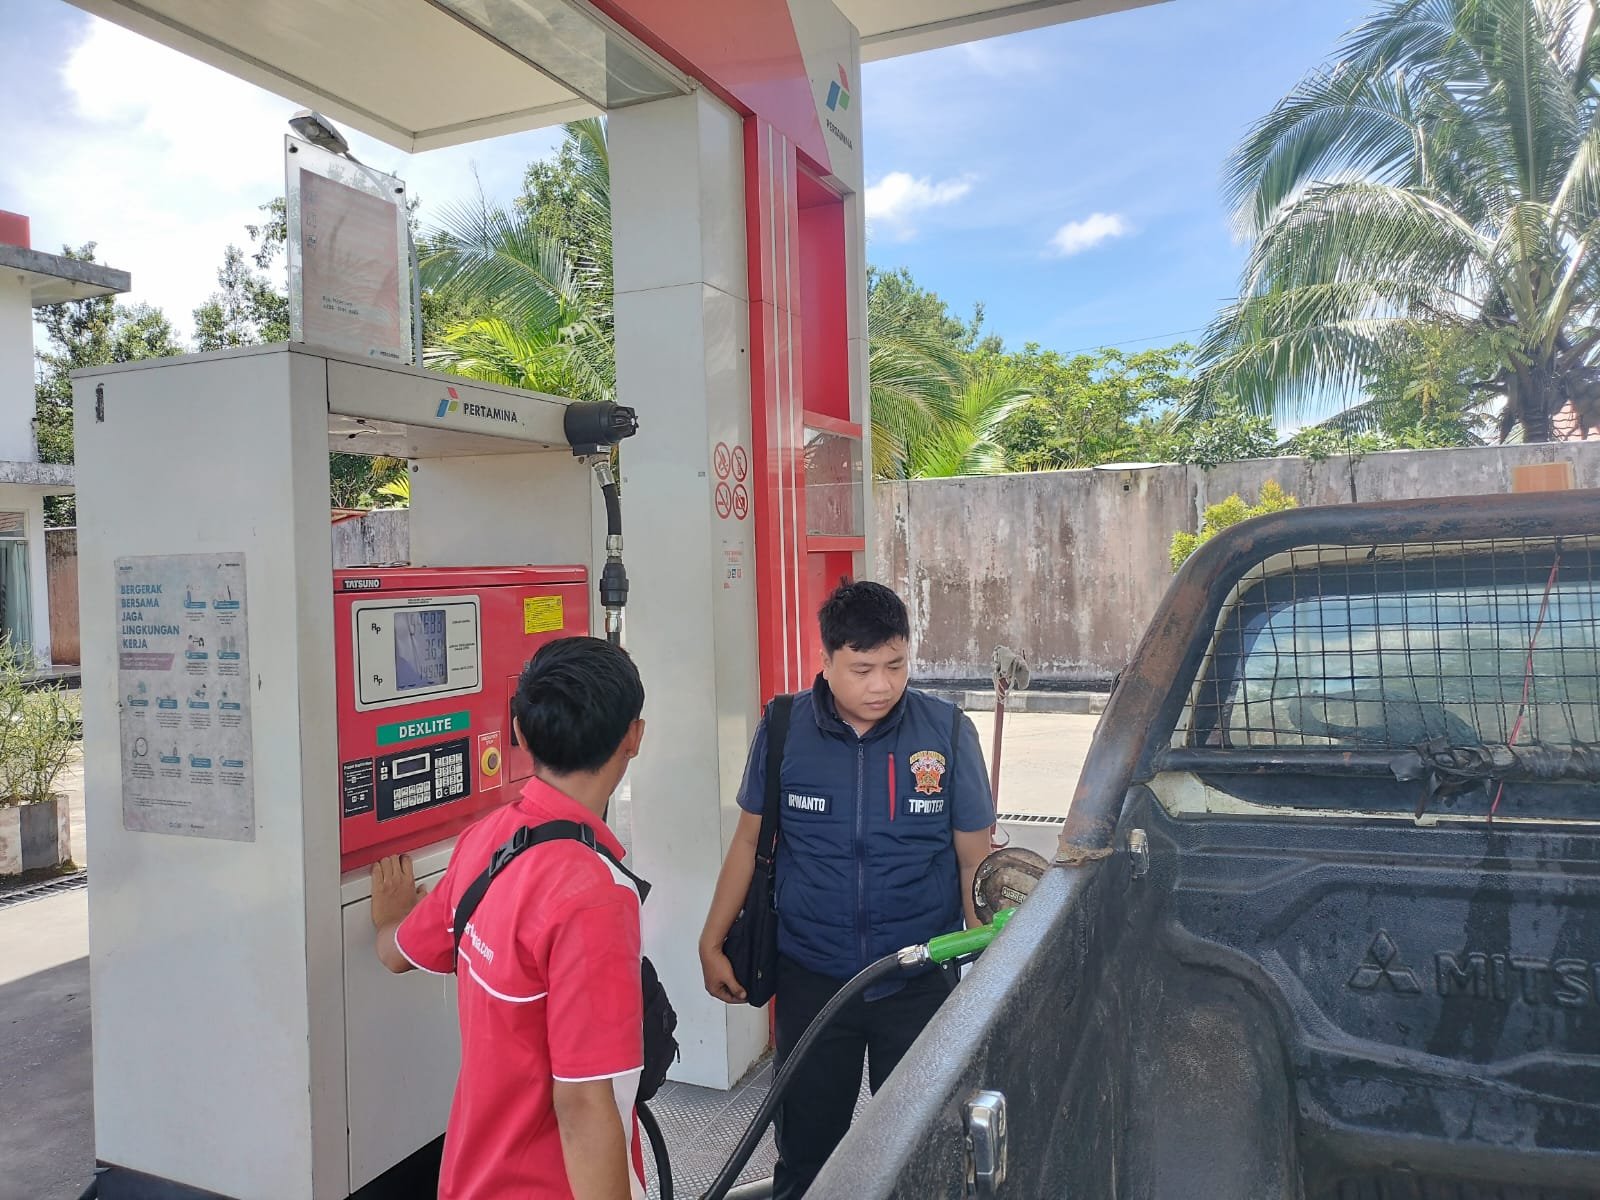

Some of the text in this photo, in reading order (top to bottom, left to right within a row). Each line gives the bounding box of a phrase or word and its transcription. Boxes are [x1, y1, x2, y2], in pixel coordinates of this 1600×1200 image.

[826, 118, 853, 151] PERTAMINA
[463, 402, 518, 423] PERTAMINA
[121, 584, 162, 594] BERGERAK
[344, 579, 380, 589] TATSUNO
[121, 598, 160, 608] BERSAMA
[121, 611, 143, 622] JAGA
[122, 625, 180, 635] LINGKUNGAN
[371, 623, 381, 635] Rp
[122, 638, 148, 649] KERJA
[373, 674, 383, 687] Rp
[399, 717, 452, 739] DEXLITE
[788, 793, 826, 812] IRWANTO
